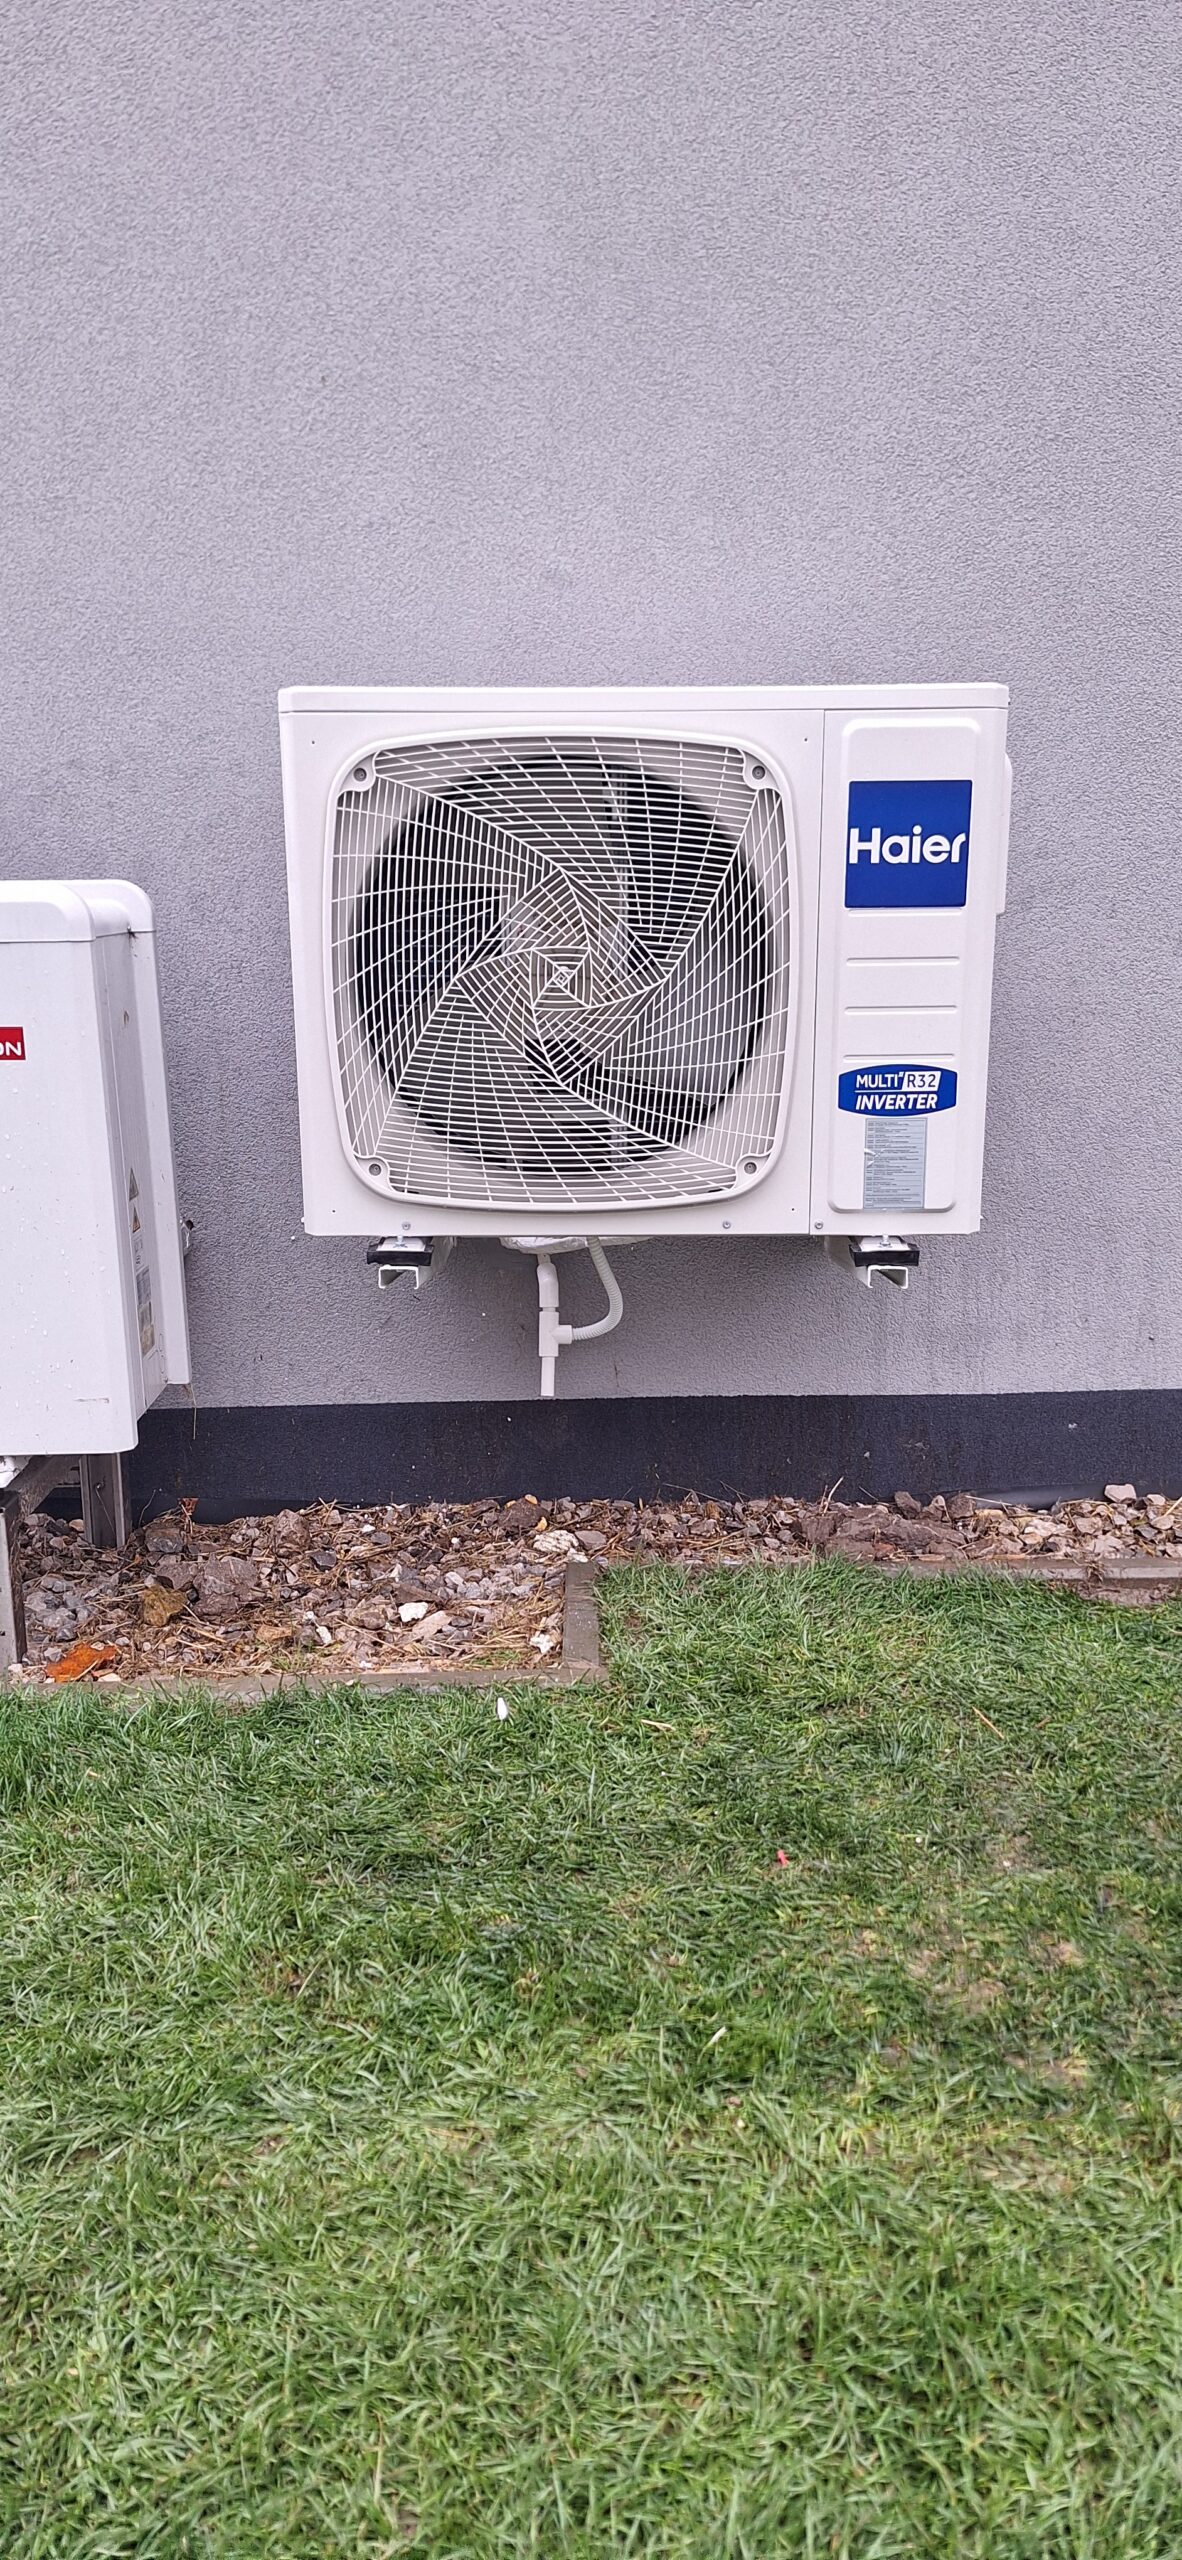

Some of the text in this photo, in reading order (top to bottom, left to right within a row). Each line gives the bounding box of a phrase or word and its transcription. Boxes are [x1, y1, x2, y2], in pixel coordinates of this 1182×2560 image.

[848, 825, 967, 864] Haier
[0, 1041, 22, 1056] N
[855, 1073, 937, 1088] MULTI R32
[855, 1093, 938, 1110] INVERTER
